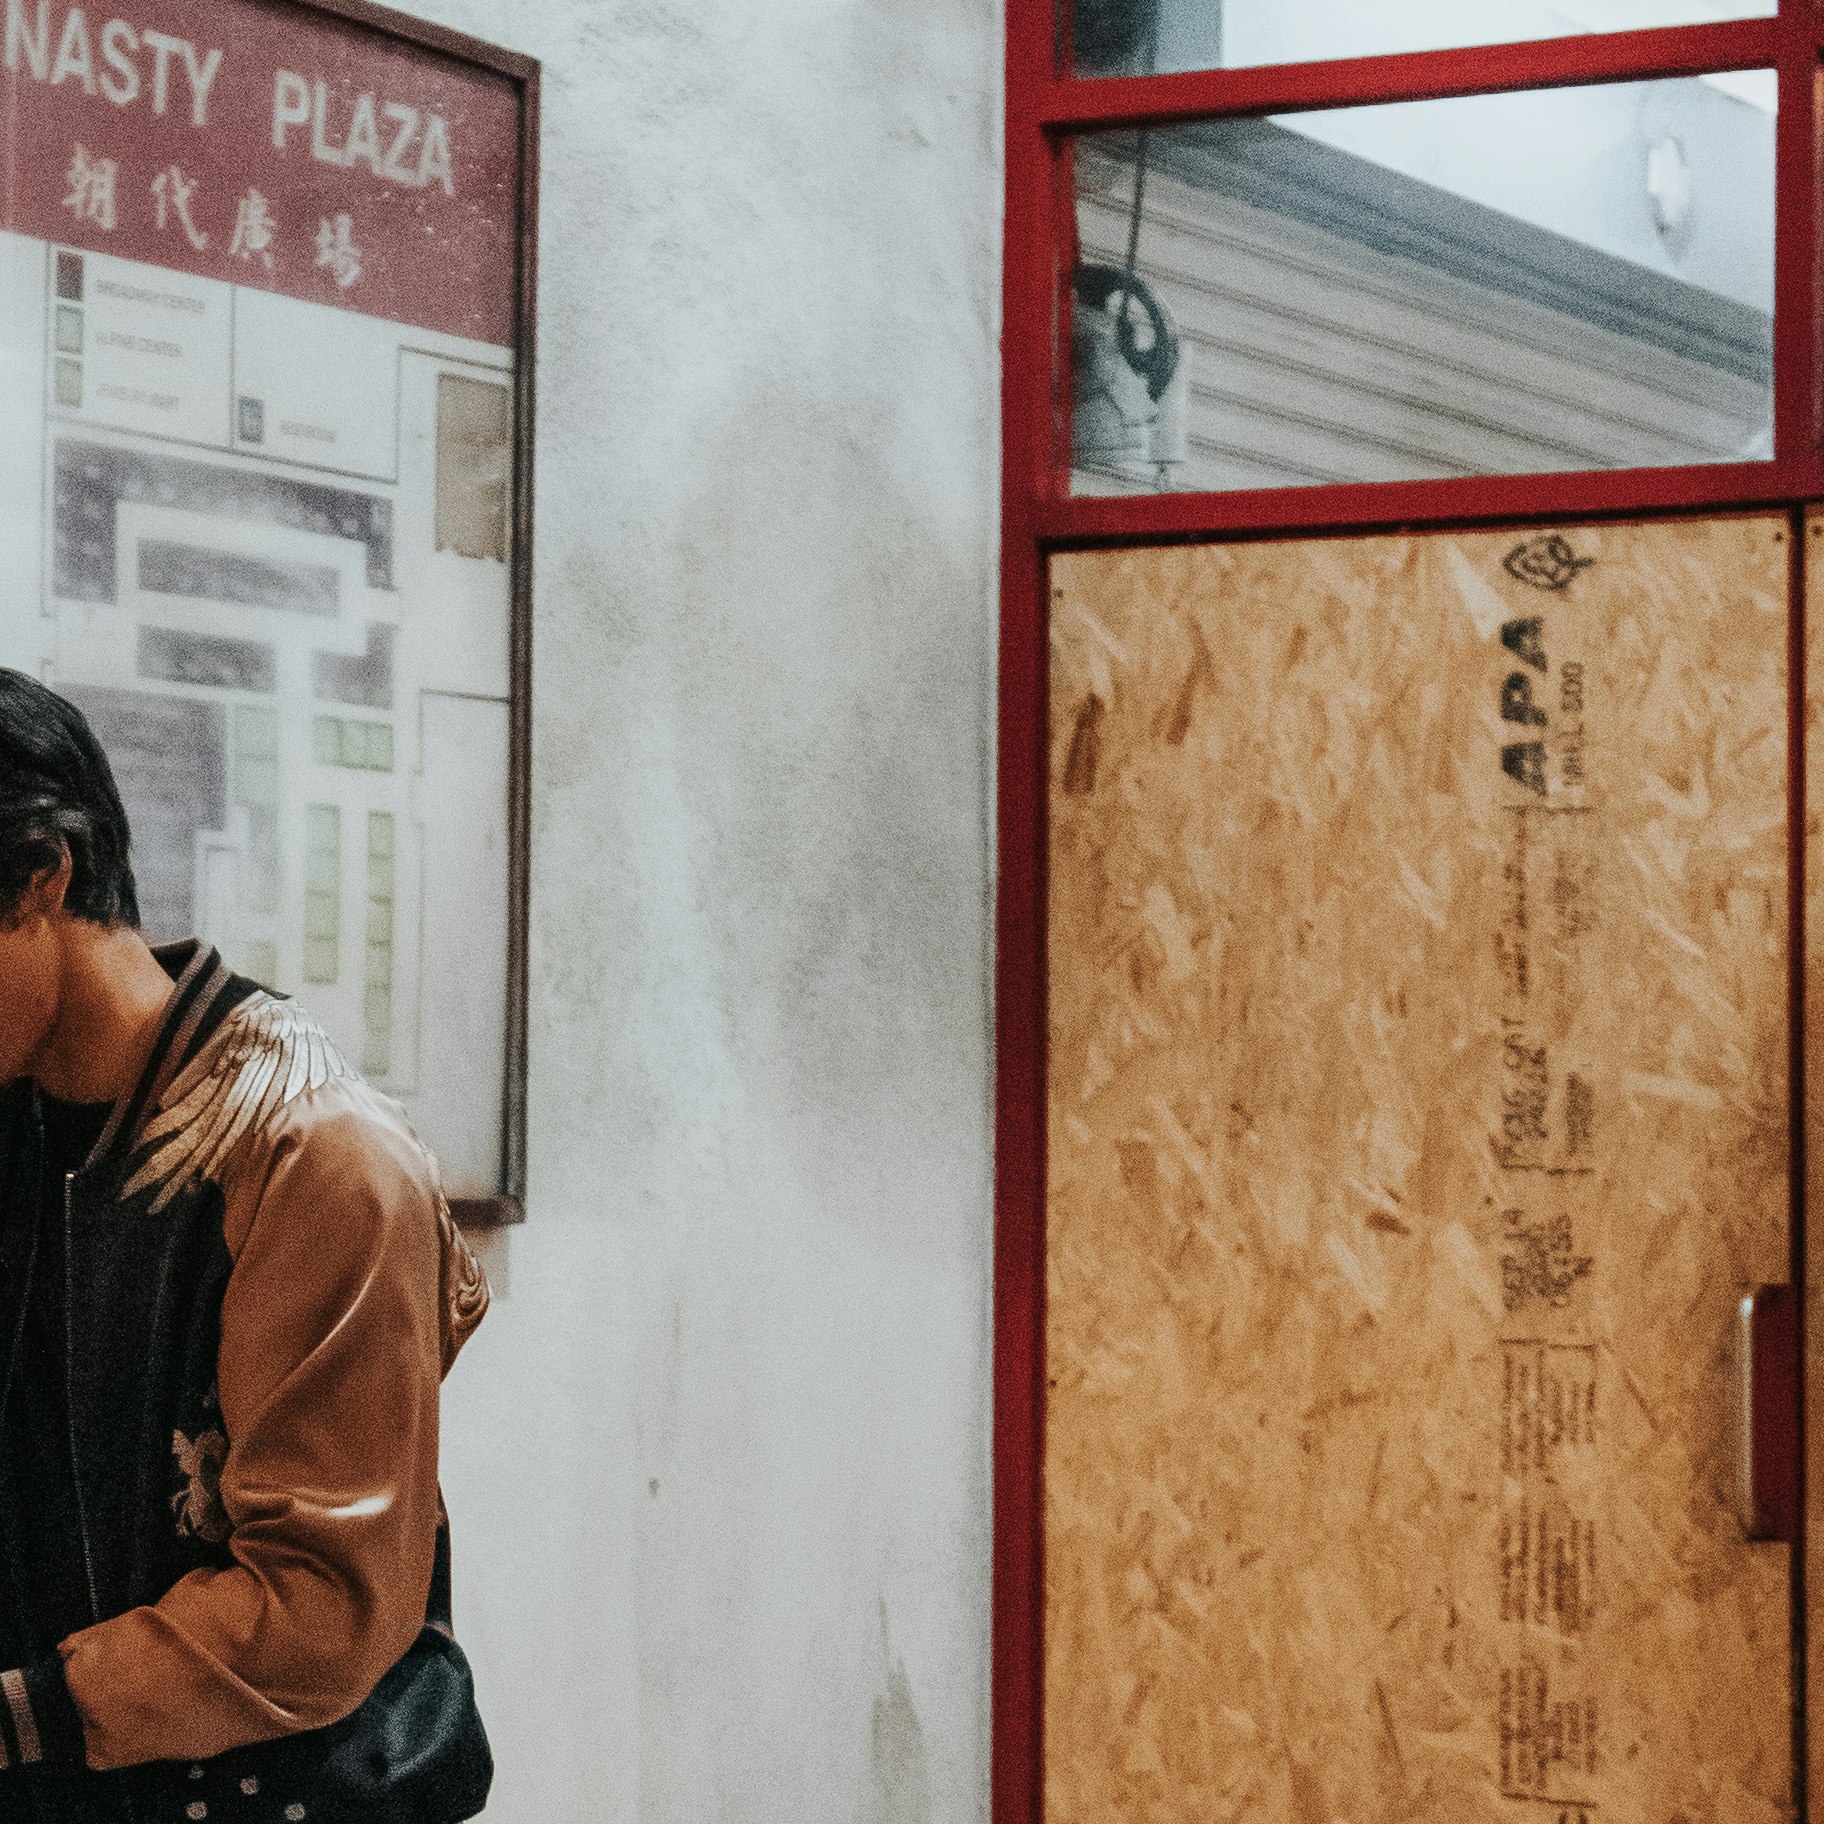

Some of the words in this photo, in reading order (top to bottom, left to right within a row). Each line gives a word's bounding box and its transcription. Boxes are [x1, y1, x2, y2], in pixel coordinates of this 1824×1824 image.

[273, 67, 456, 198] PLAZA
[62, 140, 363, 290] 朝代廣場
[1499, 616, 1549, 797] APA
